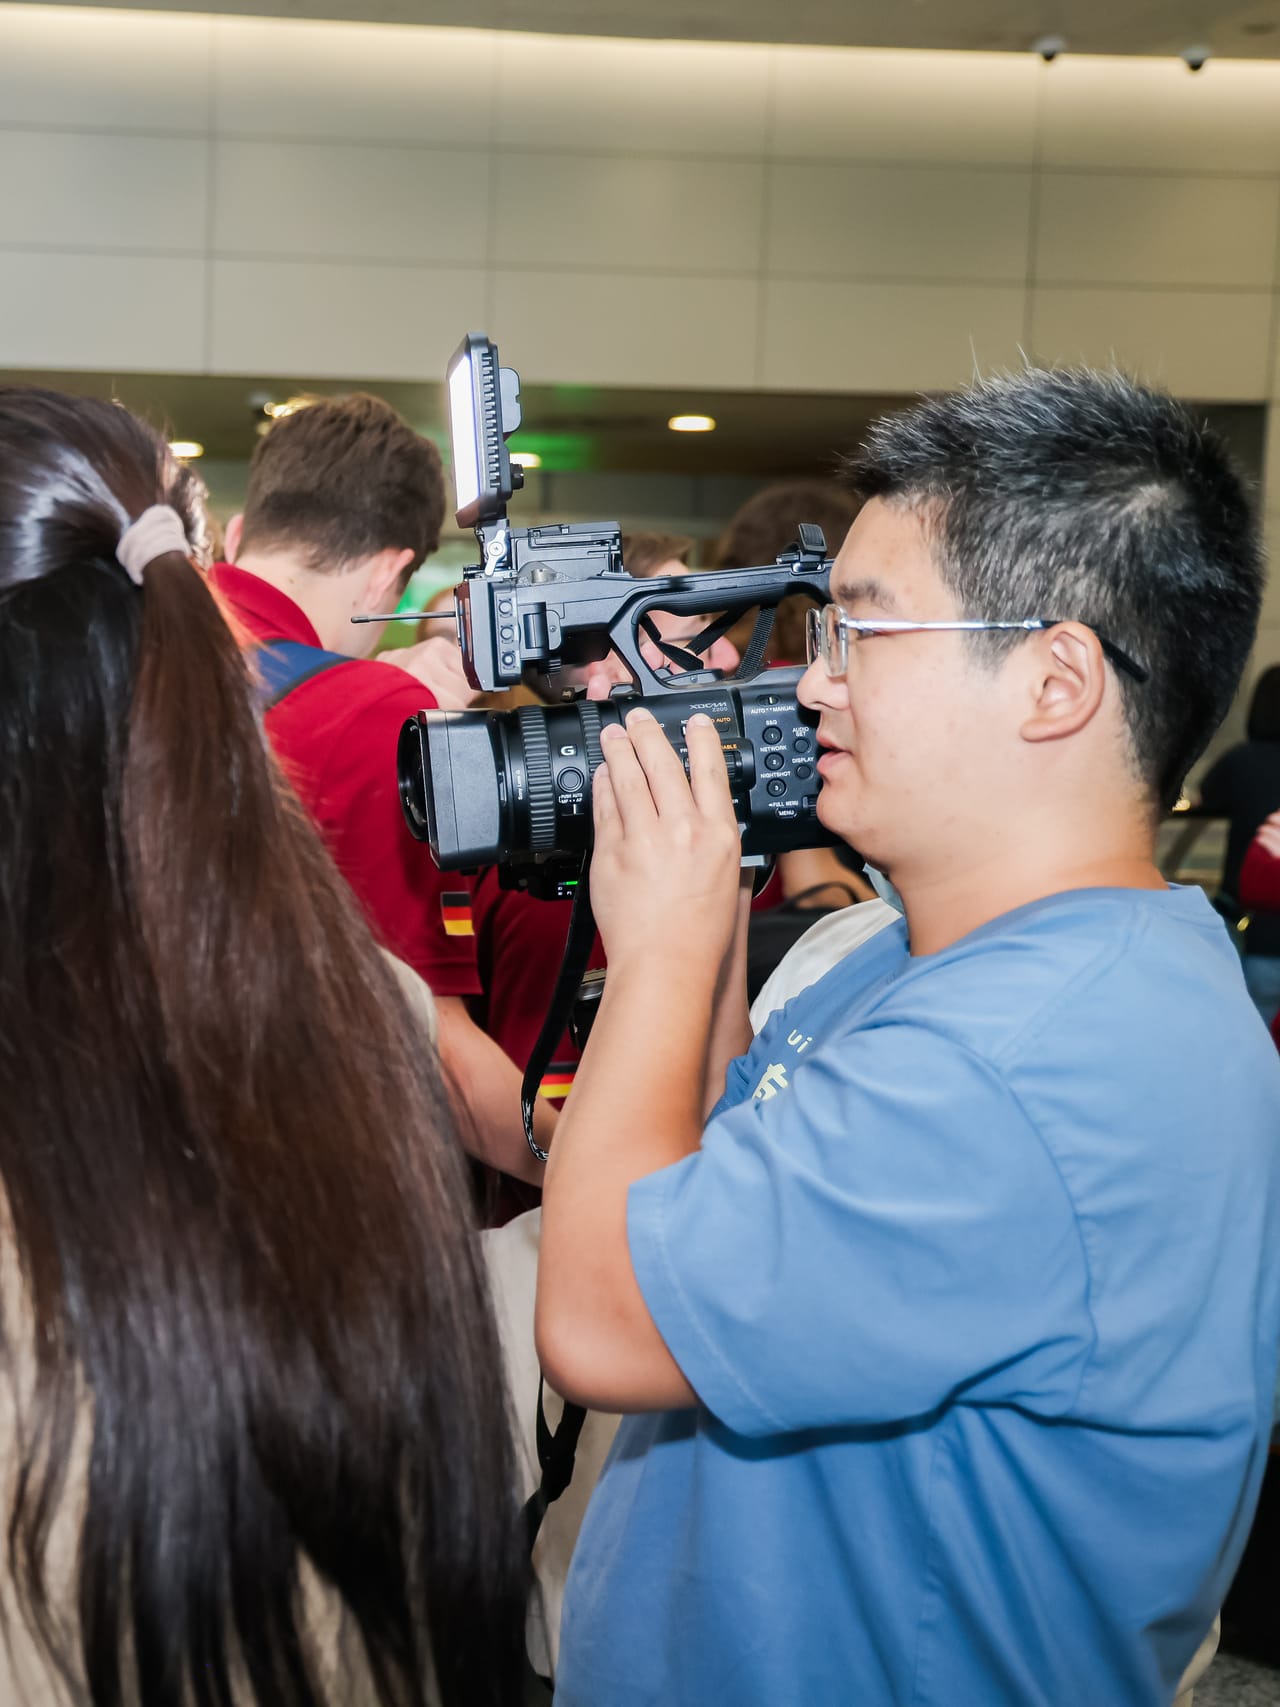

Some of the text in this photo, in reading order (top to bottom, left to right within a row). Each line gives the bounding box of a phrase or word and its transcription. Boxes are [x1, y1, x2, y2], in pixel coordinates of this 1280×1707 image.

[751, 705, 796, 715] AUTO MANUAL
[560, 745, 575, 756] G
[760, 745, 788, 753] NETWORK
[791, 756, 815, 764] DISPLAY
[760, 770, 791, 779] NIGHTSHOT
